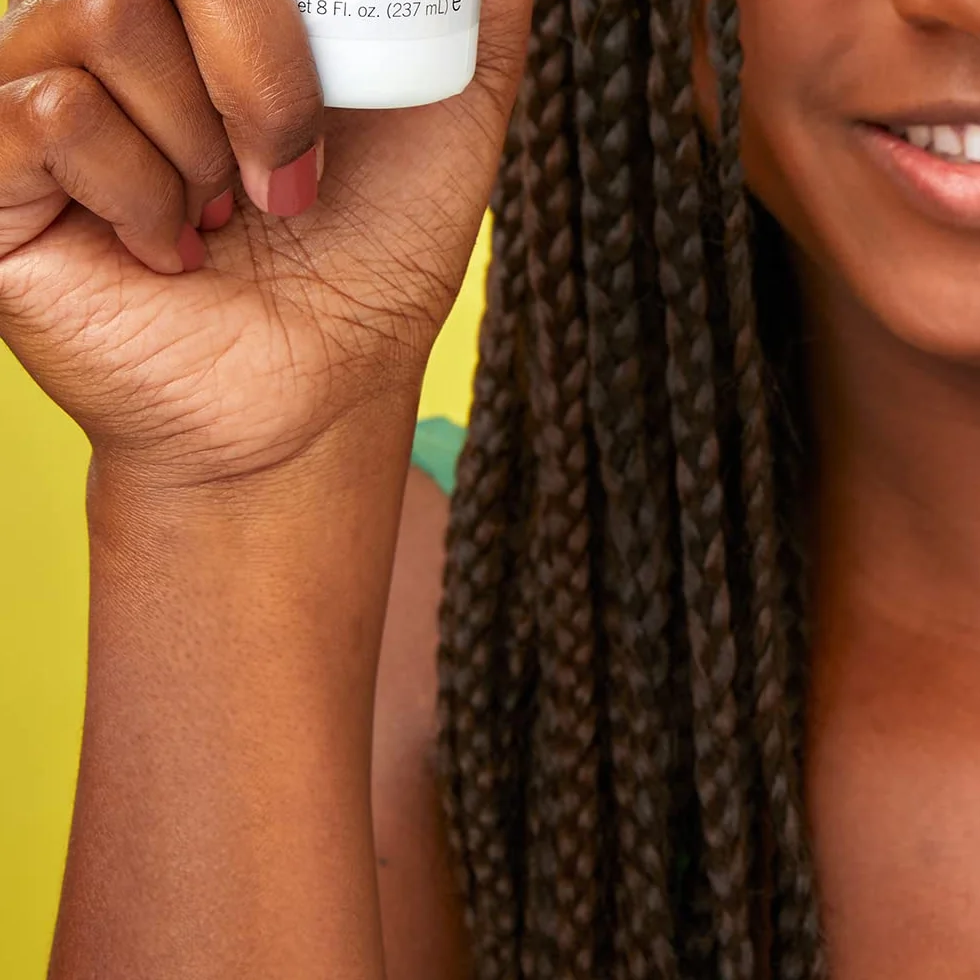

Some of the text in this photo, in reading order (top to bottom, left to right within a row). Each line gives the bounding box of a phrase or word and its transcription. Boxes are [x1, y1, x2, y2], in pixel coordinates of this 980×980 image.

[317, 0, 327, 15] 8
[358, 5, 380, 18] oz.
[387, 2, 421, 18] (237
[425, 0, 449, 15] mL)
